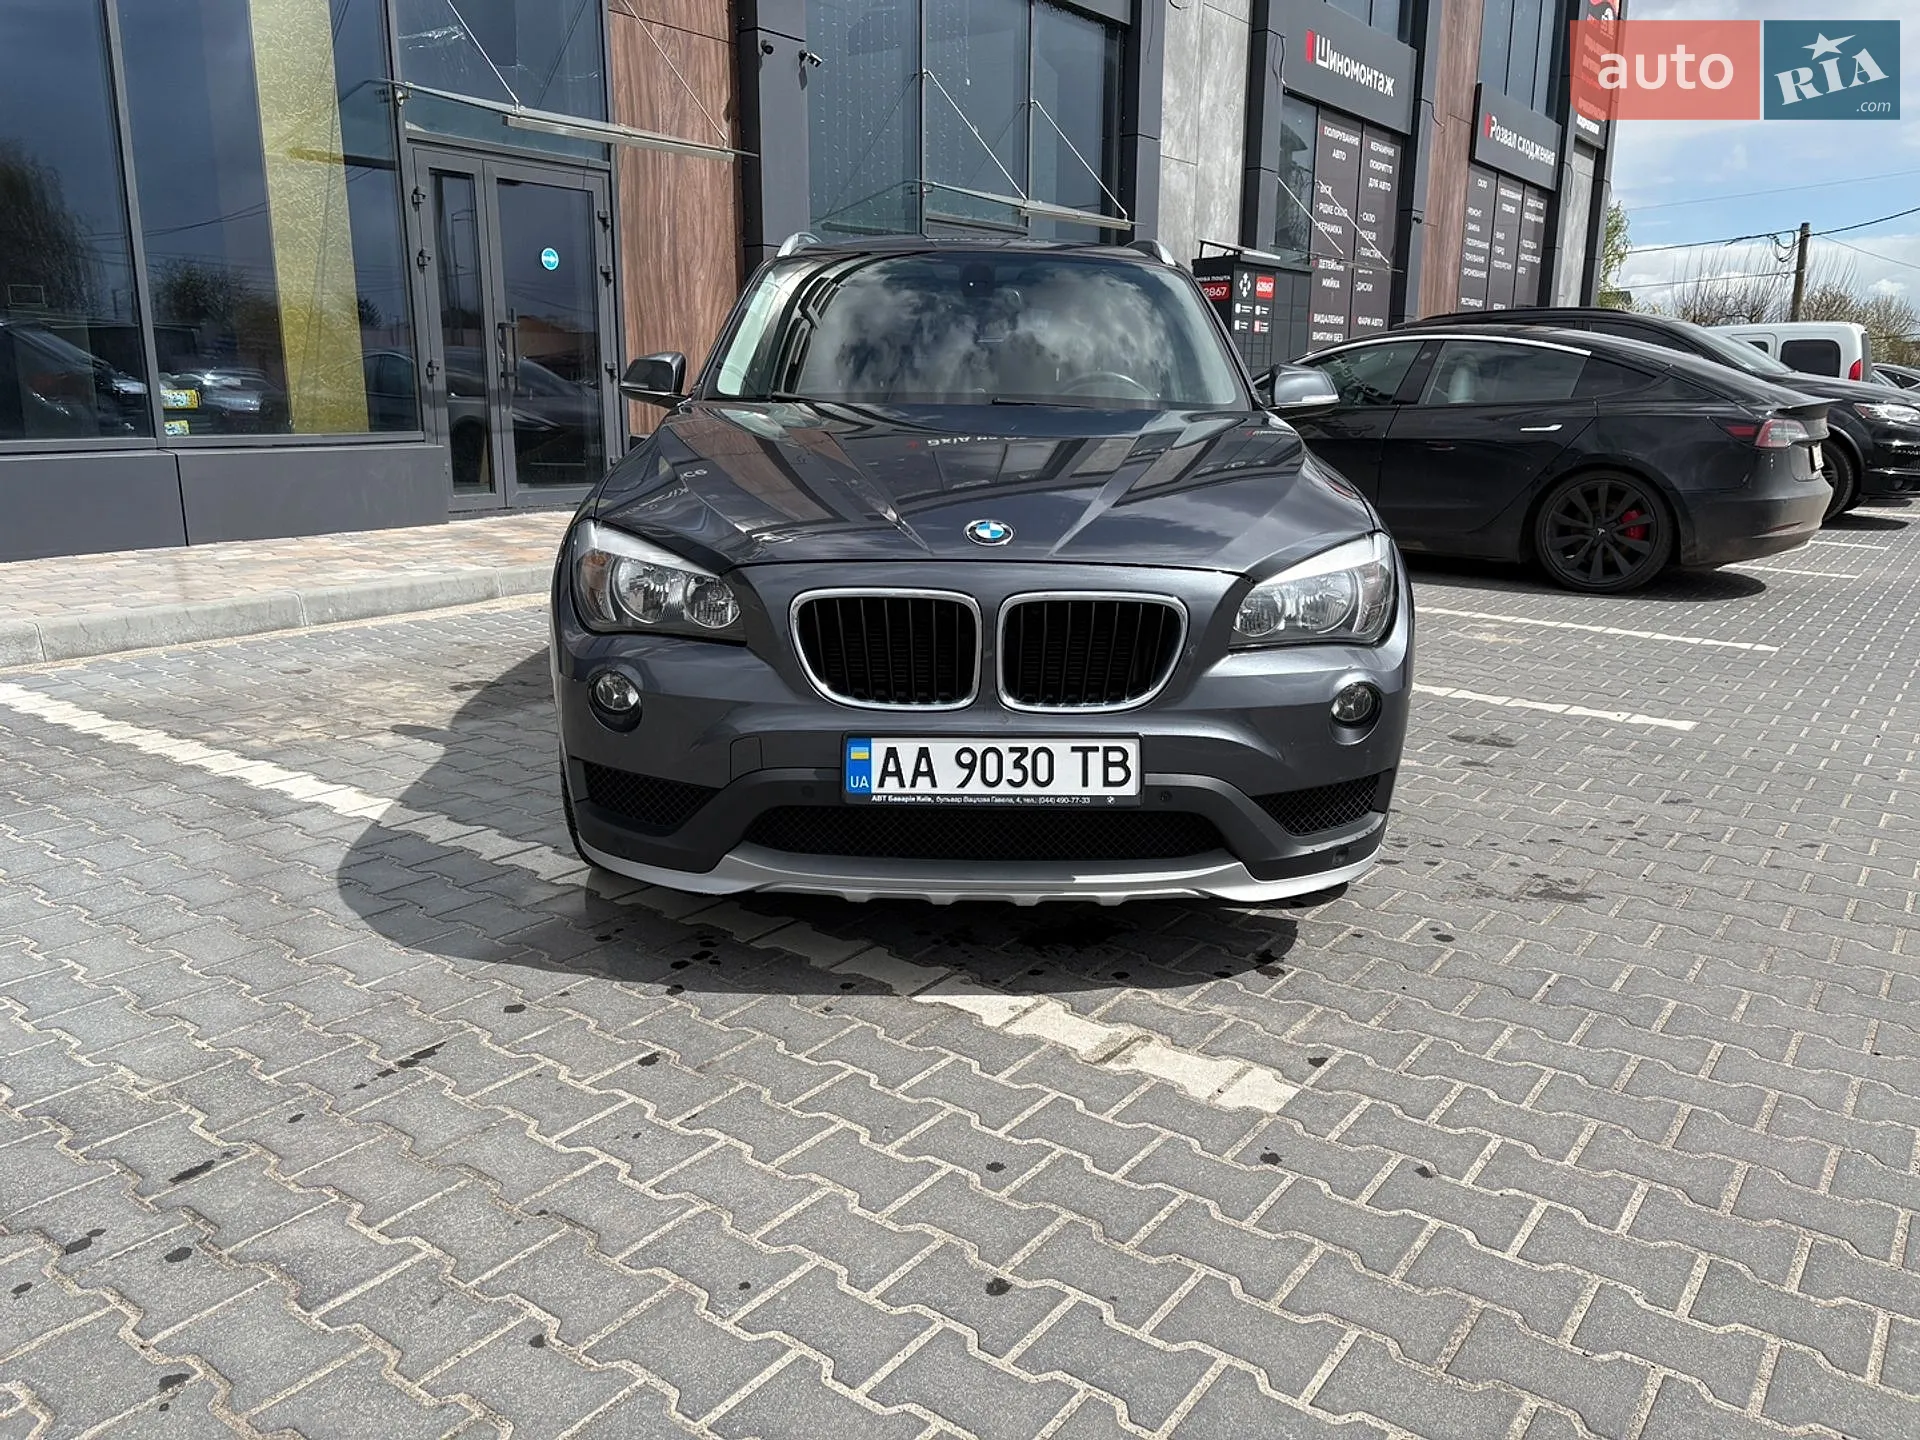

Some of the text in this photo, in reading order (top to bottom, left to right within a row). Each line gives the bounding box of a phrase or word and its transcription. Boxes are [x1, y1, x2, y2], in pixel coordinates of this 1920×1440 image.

[1316, 34, 1395, 97] Шиномонтаж
[1490, 116, 1517, 149] Розвал
[1332, 148, 1347, 161] АВТО
[1379, 181, 1391, 192] АВТО
[1322, 277, 1340, 288] МИЙКА
[1313, 313, 1344, 325] ВИДАЛЕННЯ
[1371, 317, 1383, 327] АВТО
[878, 746, 1132, 788] AA 9030 TB
[850, 776, 869, 788] UA
